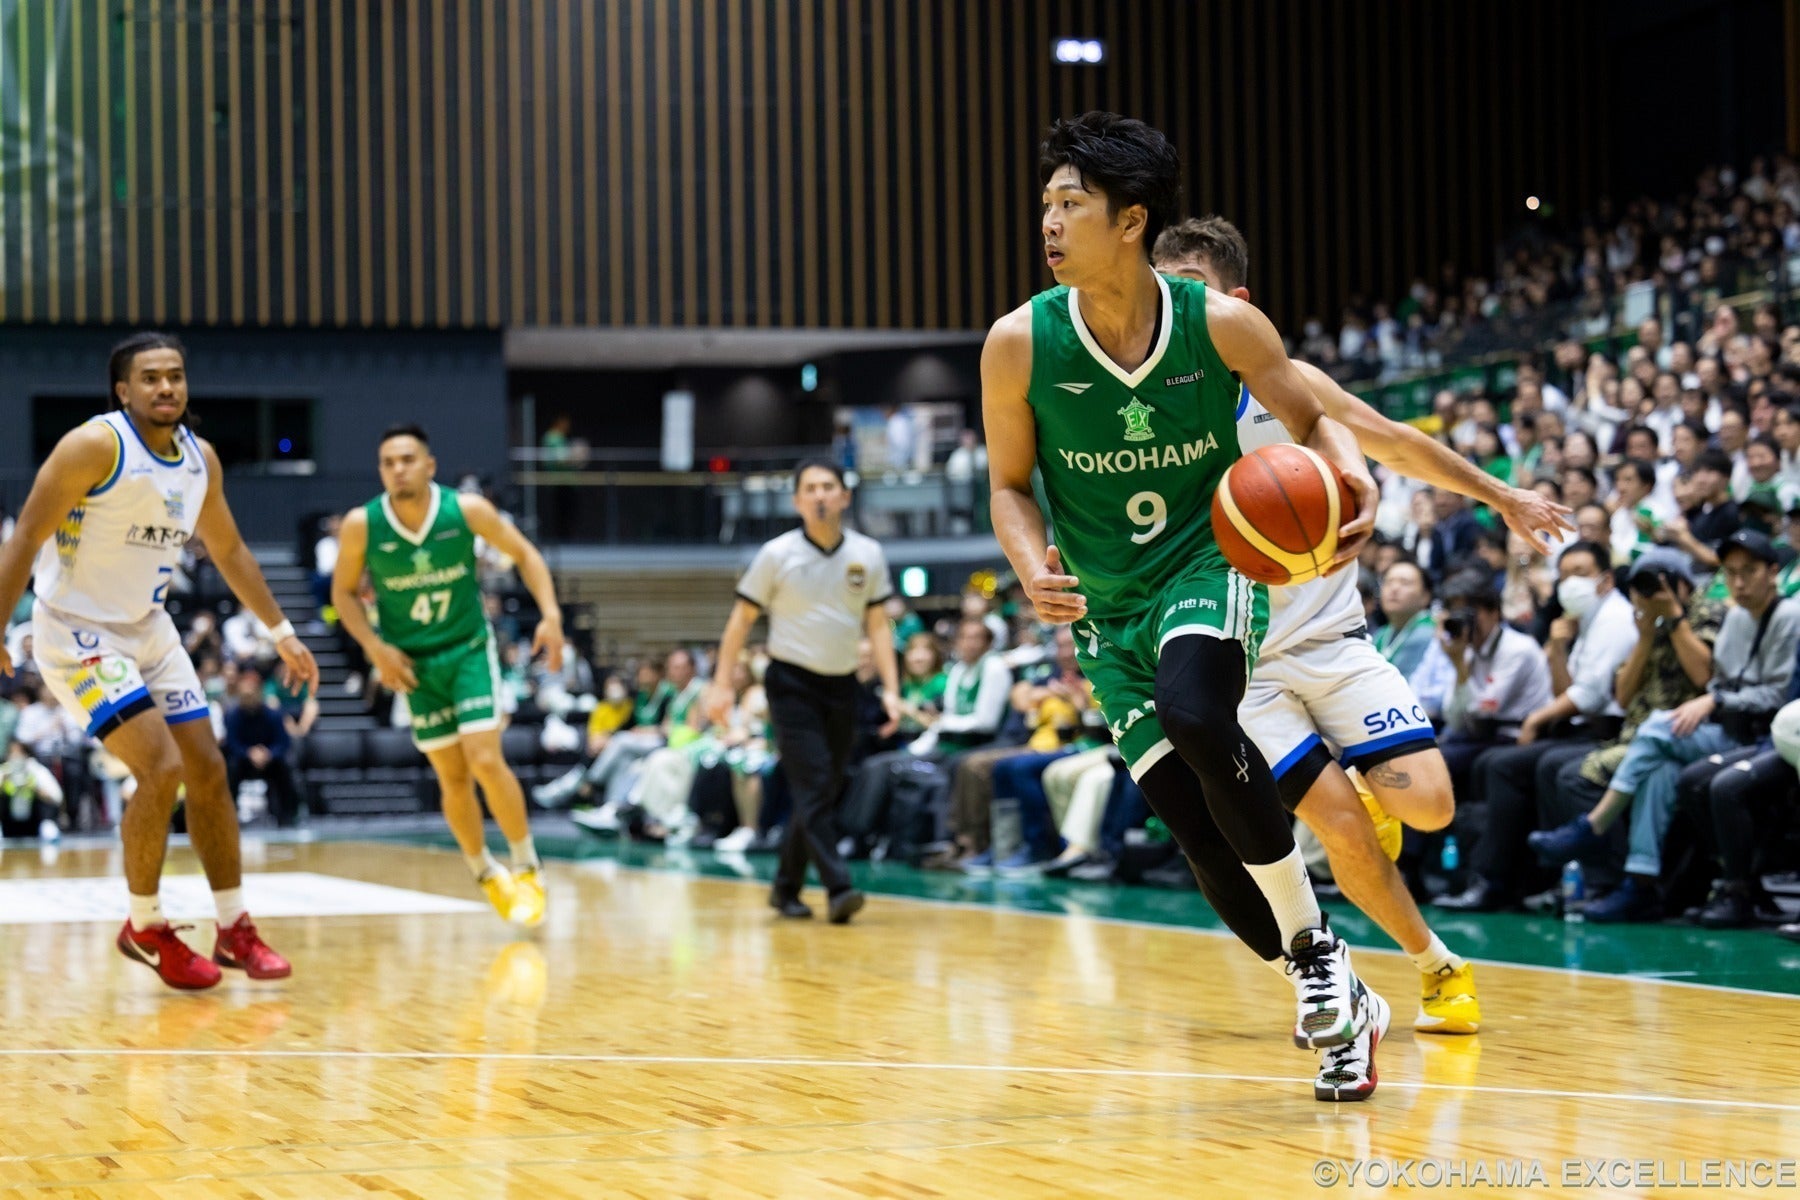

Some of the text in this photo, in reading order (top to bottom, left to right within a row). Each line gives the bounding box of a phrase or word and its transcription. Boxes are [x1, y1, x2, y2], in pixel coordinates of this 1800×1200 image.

[1127, 411, 1146, 428] EX
[1058, 431, 1219, 474] YOKOHAMA
[1125, 491, 1167, 545] 9
[409, 589, 452, 625] 47
